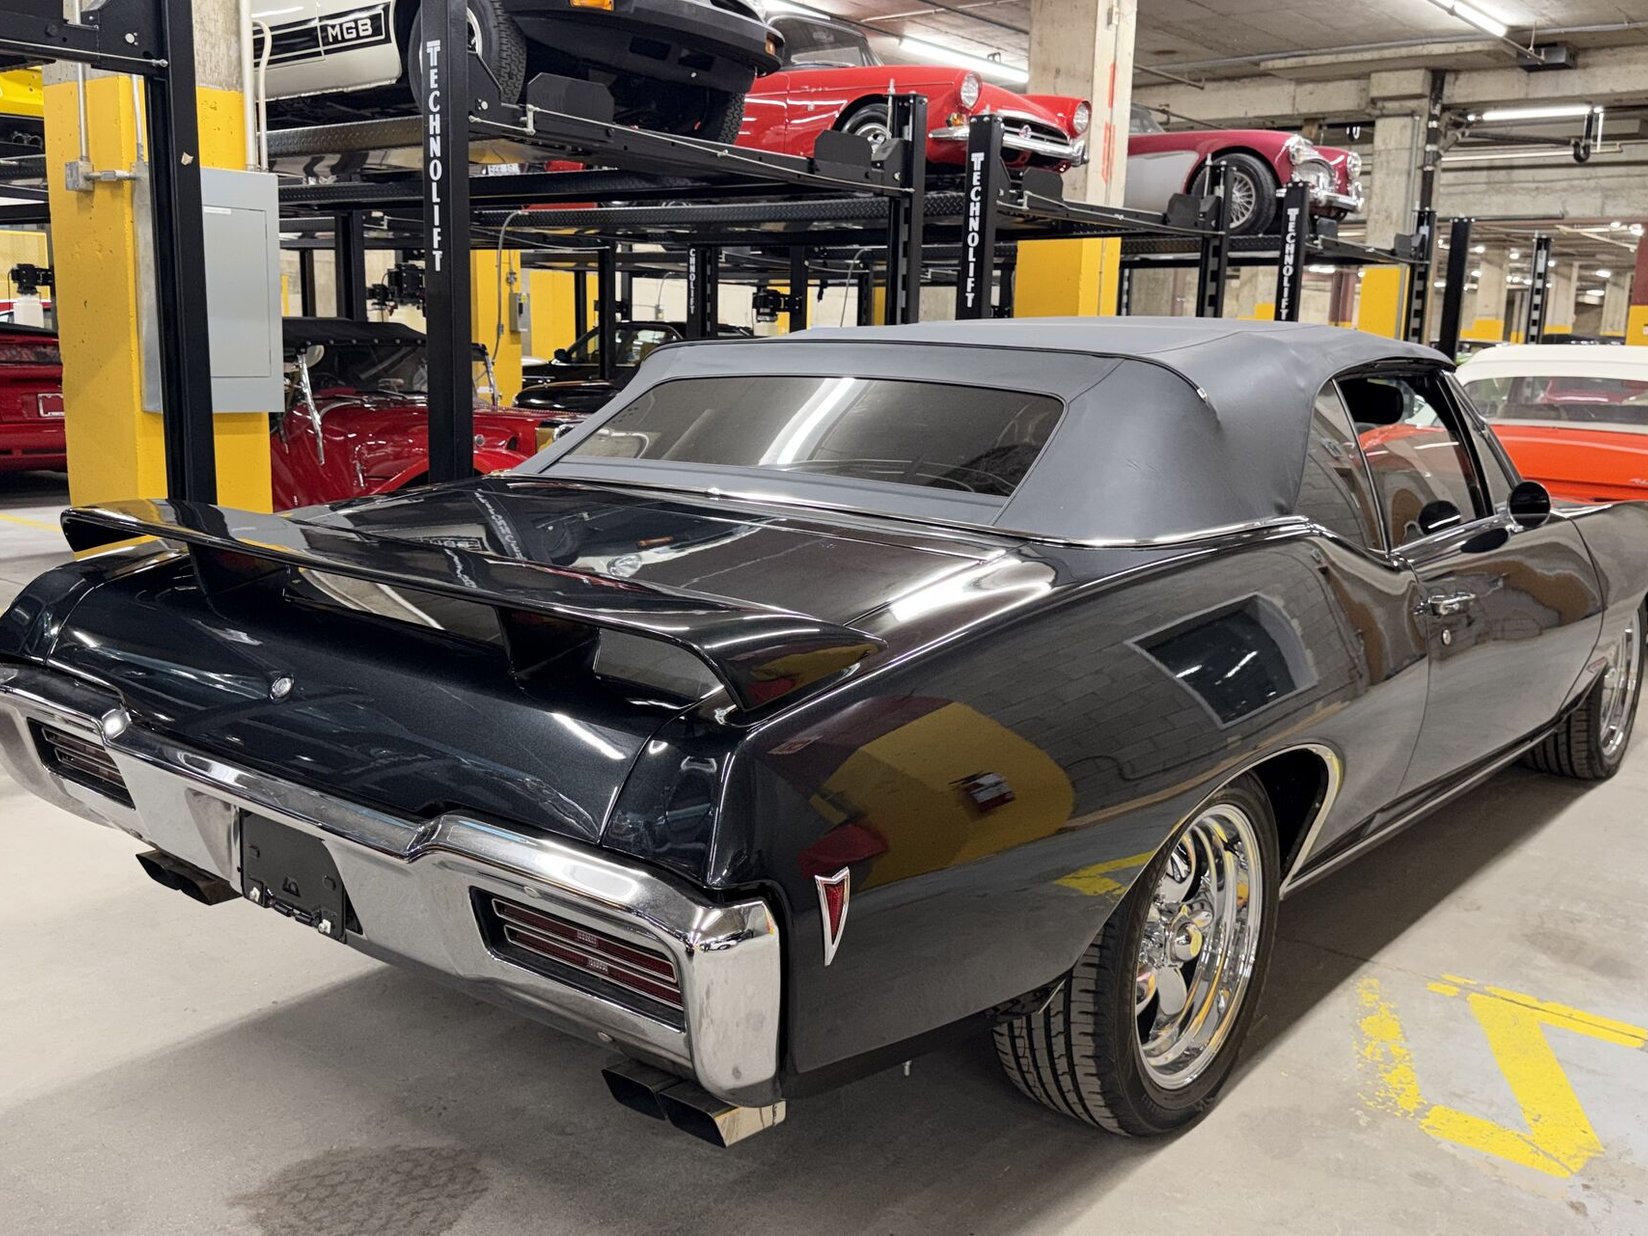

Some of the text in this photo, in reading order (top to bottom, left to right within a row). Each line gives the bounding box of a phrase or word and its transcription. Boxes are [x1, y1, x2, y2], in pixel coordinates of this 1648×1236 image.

[327, 18, 373, 43] MGB
[426, 39, 443, 272] TECHNOLIFT
[689, 248, 697, 314] CHNOLIFT
[965, 152, 985, 308] TECHNOLIFT
[1280, 207, 1300, 320] TECHNOLIFT
